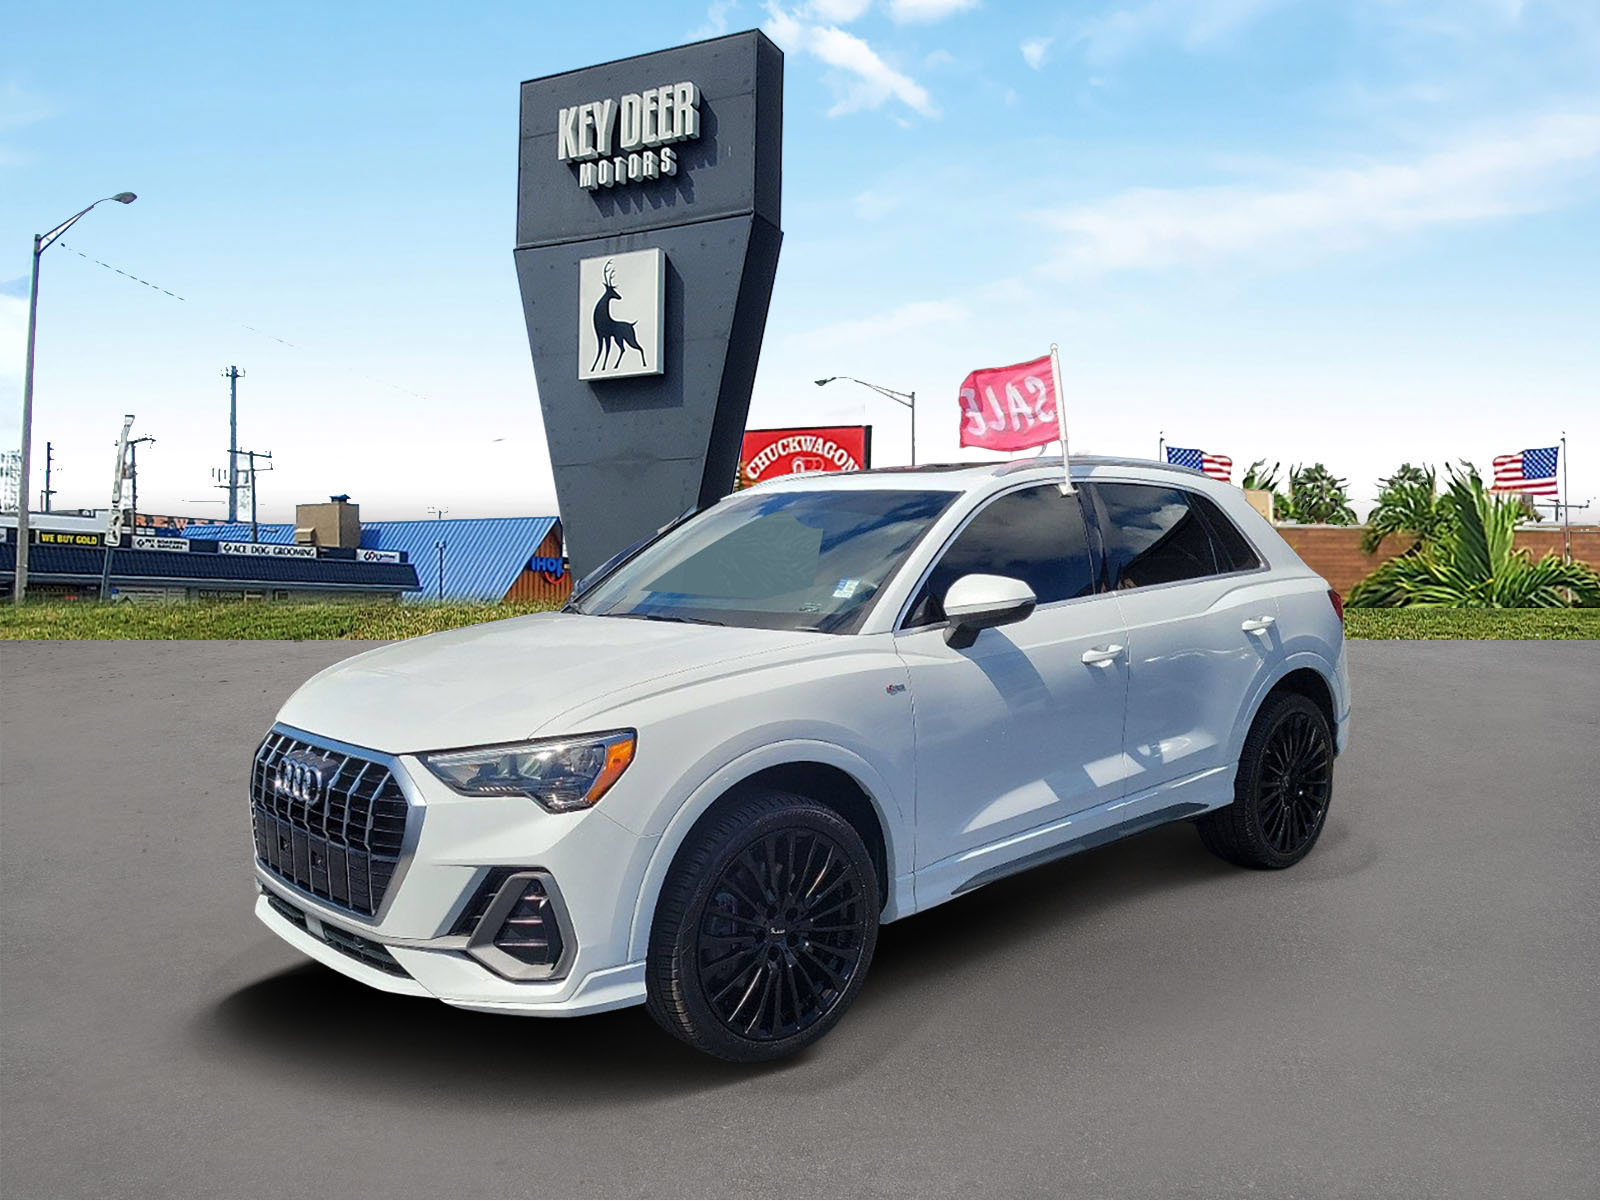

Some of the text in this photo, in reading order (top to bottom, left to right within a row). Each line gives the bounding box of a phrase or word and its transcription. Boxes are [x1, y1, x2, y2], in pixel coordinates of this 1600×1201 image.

[558, 81, 700, 163] KEY DEER
[579, 147, 677, 191] MOTORS
[746, 435, 860, 480] CHUCKWAGON
[41, 533, 97, 545] WE BUY GOLD
[251, 545, 270, 555] DOG
[272, 546, 315, 557] GROOMING
